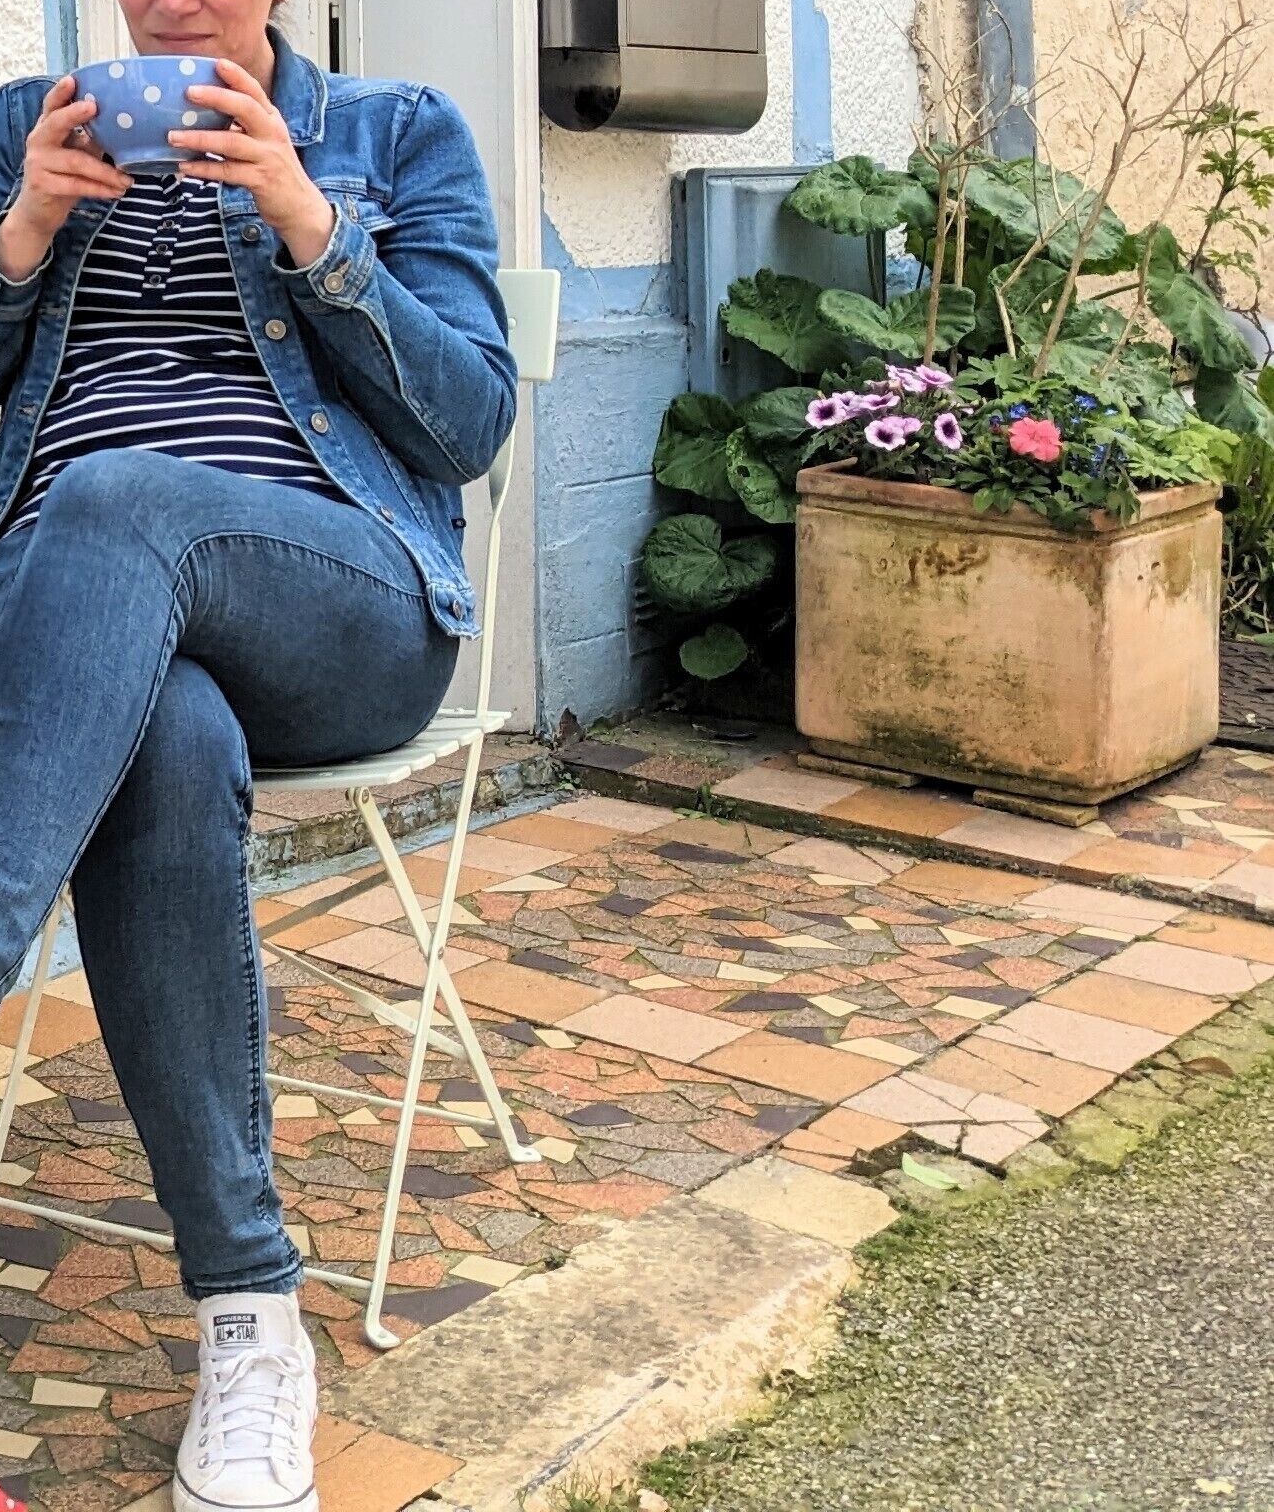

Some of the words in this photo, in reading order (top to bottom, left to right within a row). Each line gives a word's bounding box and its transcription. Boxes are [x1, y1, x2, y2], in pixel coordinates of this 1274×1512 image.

[215, 1315, 252, 1324] CONVERSE
[217, 1326, 226, 1341] ALL
[236, 1325, 256, 1340] STAR
